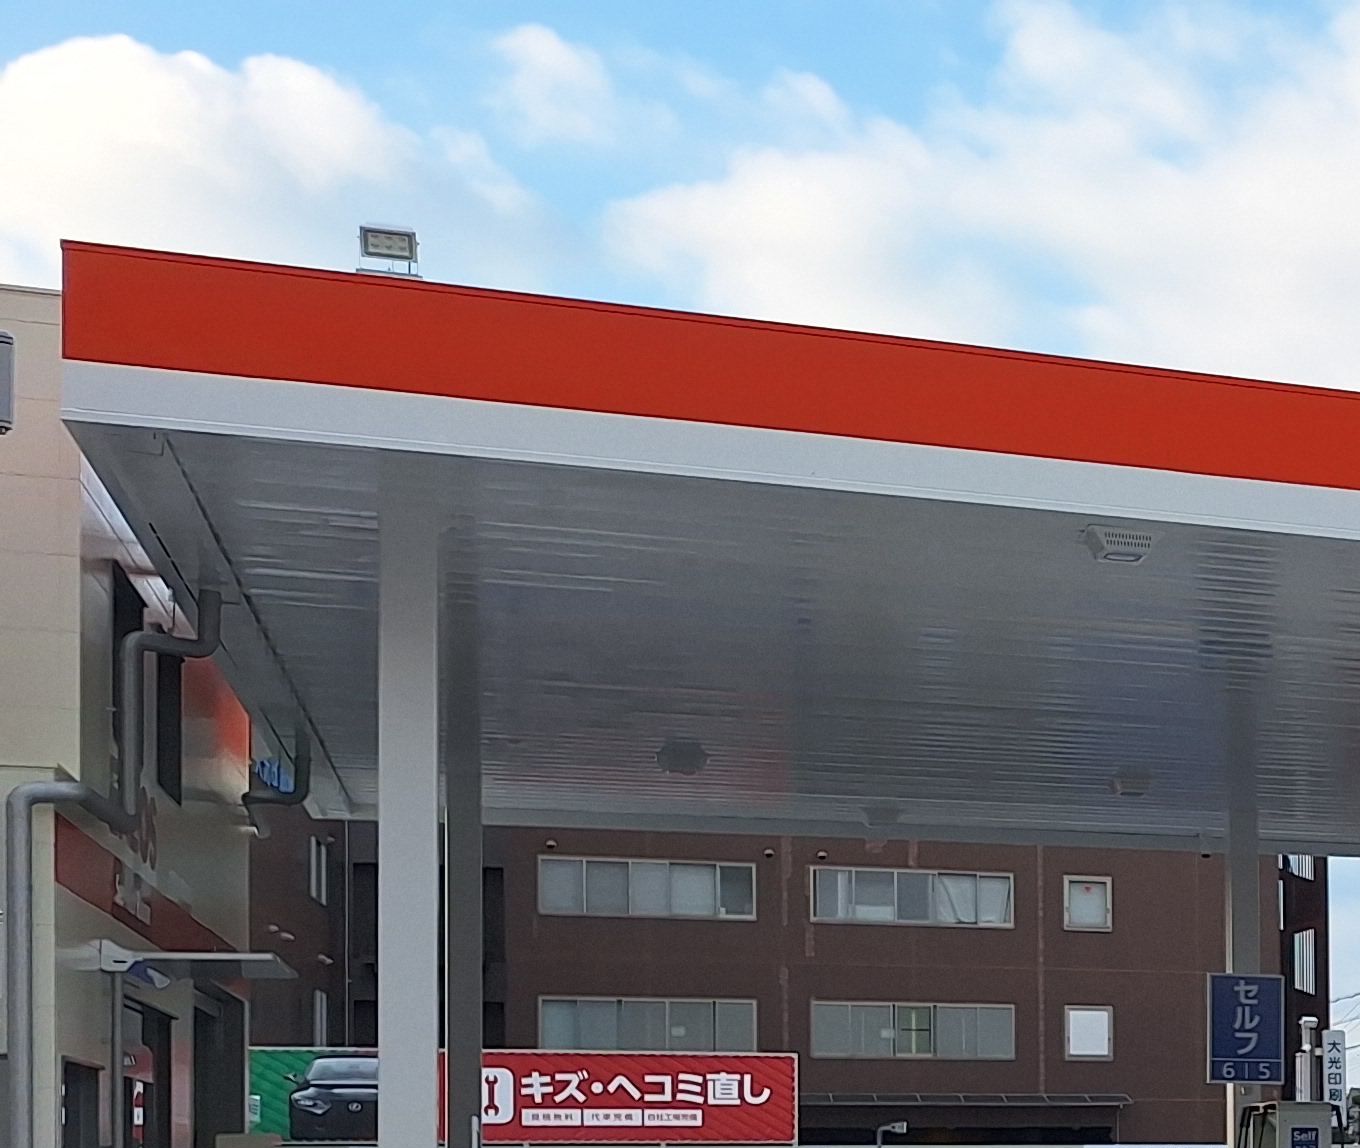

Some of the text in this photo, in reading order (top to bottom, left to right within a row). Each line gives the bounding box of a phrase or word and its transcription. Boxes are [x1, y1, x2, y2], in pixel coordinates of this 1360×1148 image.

[1233, 980, 1260, 1055] セルフ
[520, 1069, 771, 1105] キズ・ヘコミ直し
[1222, 1062, 1271, 1080] 6 5
[1327, 1040, 1342, 1102] 大光印刷
[1293, 1130, 1317, 1142] Self
